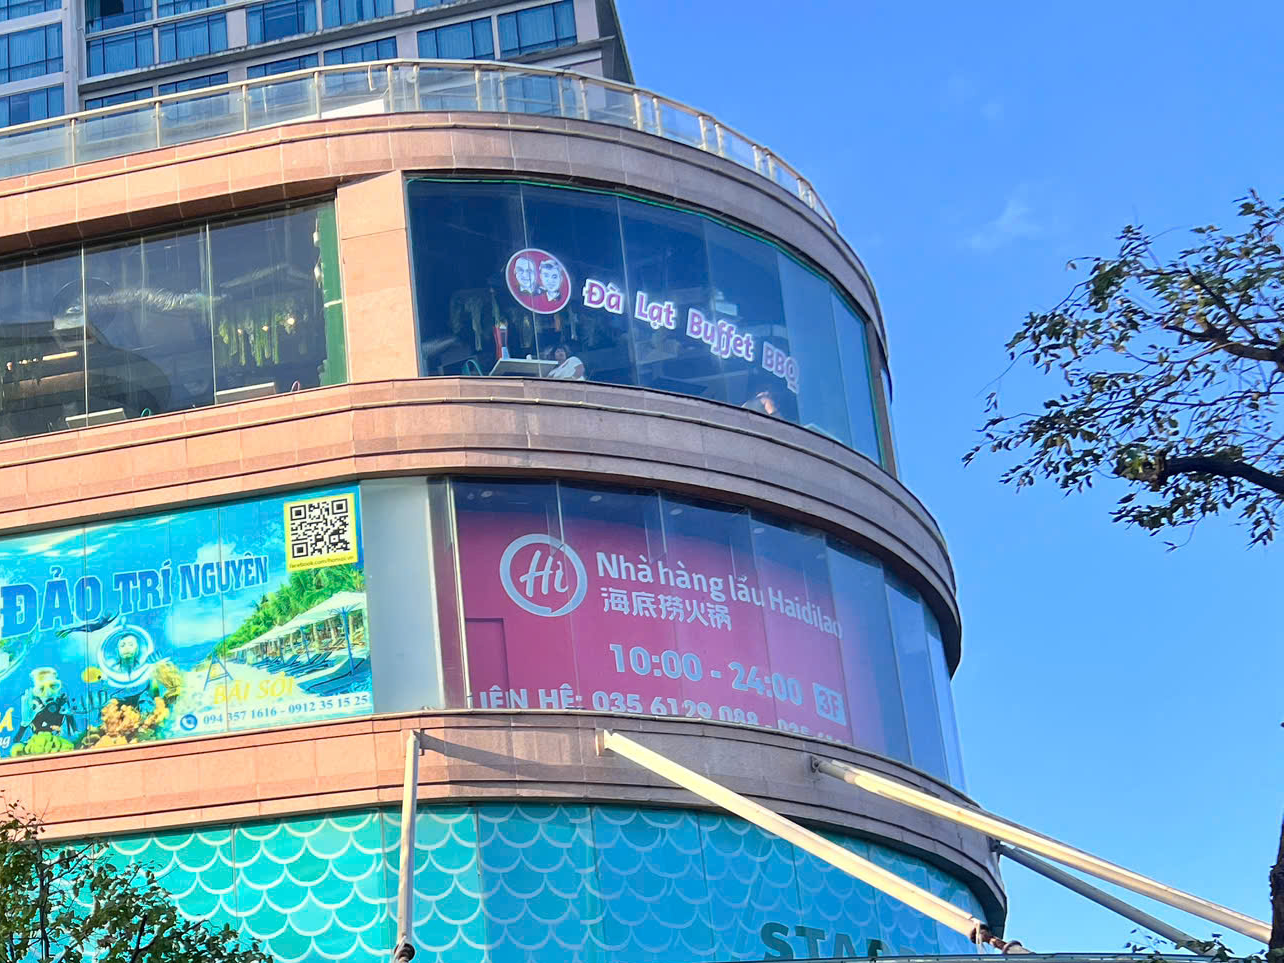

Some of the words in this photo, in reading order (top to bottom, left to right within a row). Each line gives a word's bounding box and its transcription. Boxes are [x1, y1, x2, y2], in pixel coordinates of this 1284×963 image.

[583, 279, 624, 315] Đà
[635, 291, 676, 331] Lạt
[687, 308, 755, 362] Buffet
[762, 342, 800, 394] BBQ
[0, 567, 104, 638] ĐẢO
[113, 565, 172, 616] TRÍ
[181, 552, 269, 600] NGUYÊN
[520, 549, 570, 598] Hi
[596, 552, 654, 582] Nhà
[658, 562, 723, 602] hàng
[768, 587, 843, 640] Haidilao
[203, 714, 223, 725] 094
[228, 711, 247, 721] 357
[251, 707, 277, 719] 1616
[288, 702, 316, 714] 0912
[319, 699, 334, 709] 35
[338, 697, 352, 708] 15
[355, 695, 368, 706] 25
[609, 643, 702, 682] 10:00
[730, 662, 803, 706] 24:00
